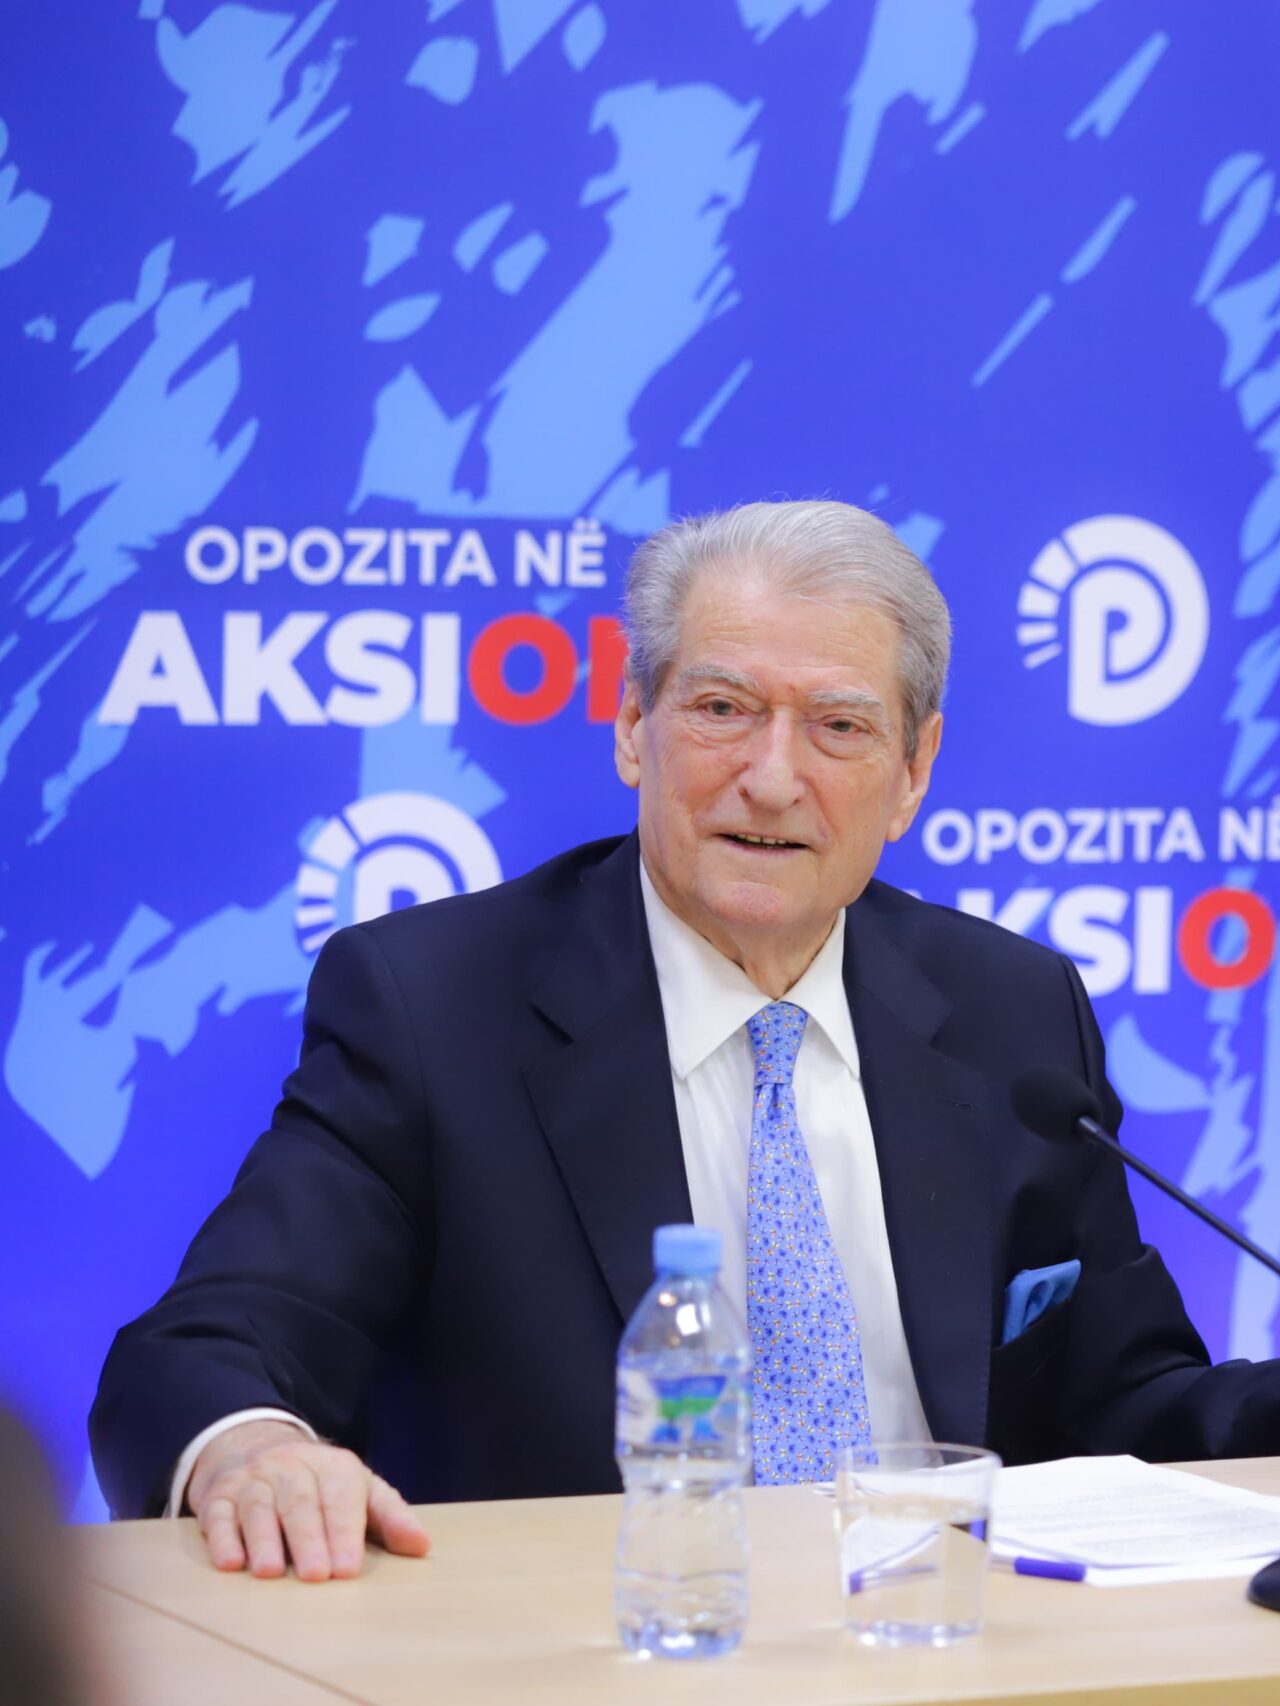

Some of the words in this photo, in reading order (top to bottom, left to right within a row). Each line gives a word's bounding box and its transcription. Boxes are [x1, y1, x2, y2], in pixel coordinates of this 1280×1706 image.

[184, 526, 497, 586] OPOZITA
[514, 518, 607, 587] NË
[922, 808, 1205, 866] OPOZITA
